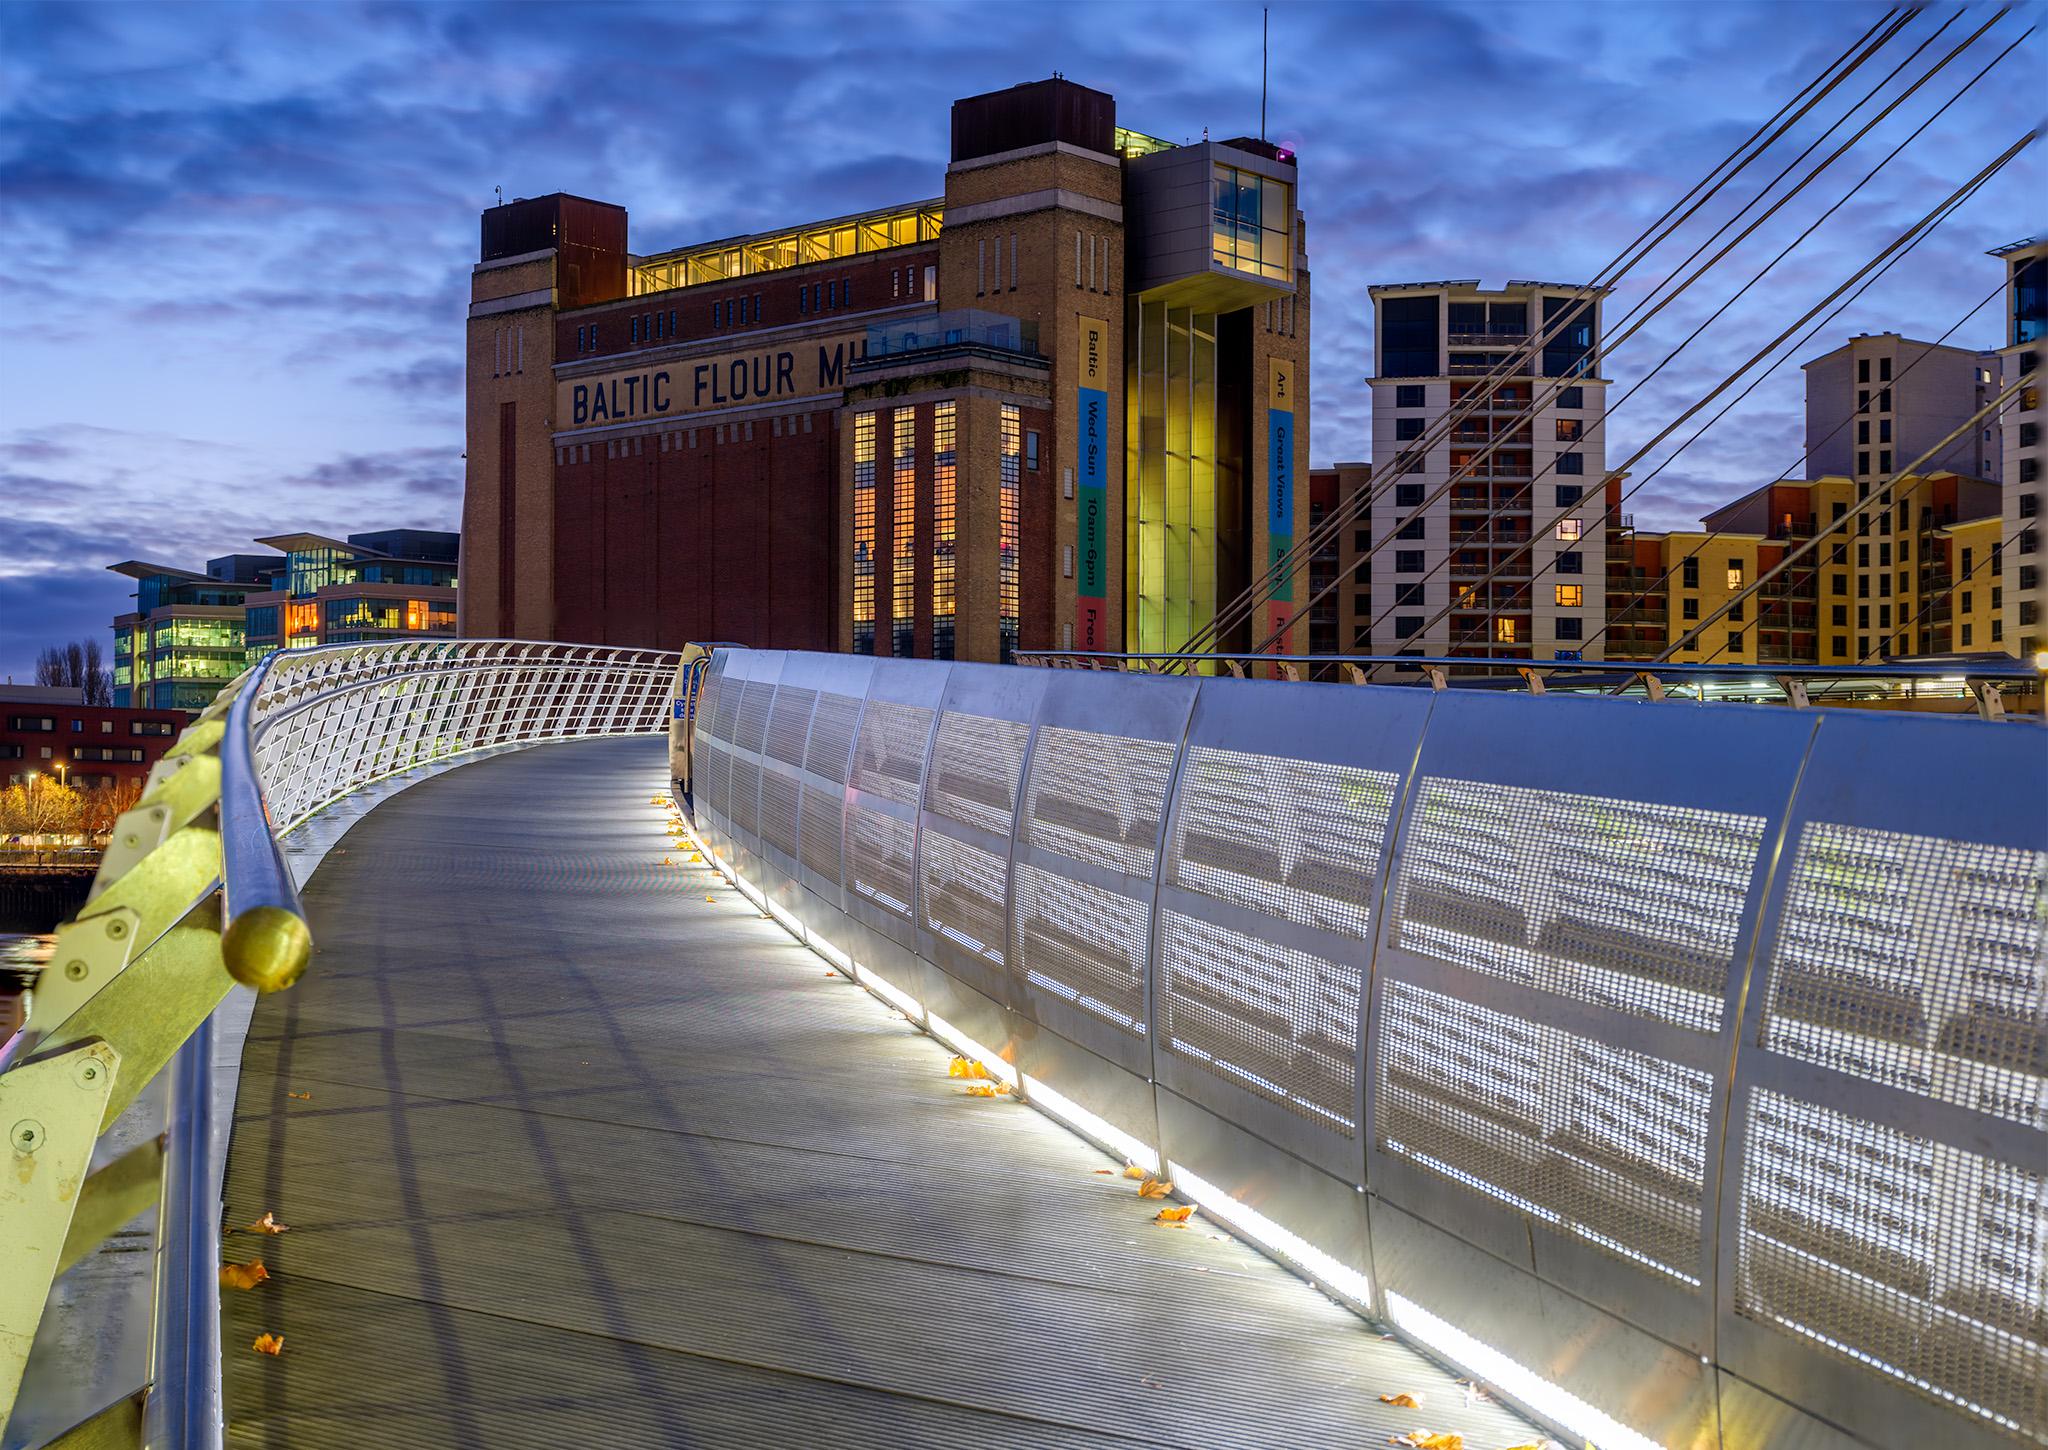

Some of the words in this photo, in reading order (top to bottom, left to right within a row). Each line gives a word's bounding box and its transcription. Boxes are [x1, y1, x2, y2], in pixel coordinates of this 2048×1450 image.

[1088, 330, 1098, 378] Baltic
[573, 371, 670, 424] BALTIC
[694, 351, 795, 407] FLOUR
[1277, 371, 1286, 399] Art
[1088, 401, 1098, 476] Wed-Sun
[1277, 426, 1286, 470] Great
[1276, 474, 1285, 519] Views
[1086, 498, 1097, 586] 10am-6pm
[1087, 609, 1097, 646] Free
